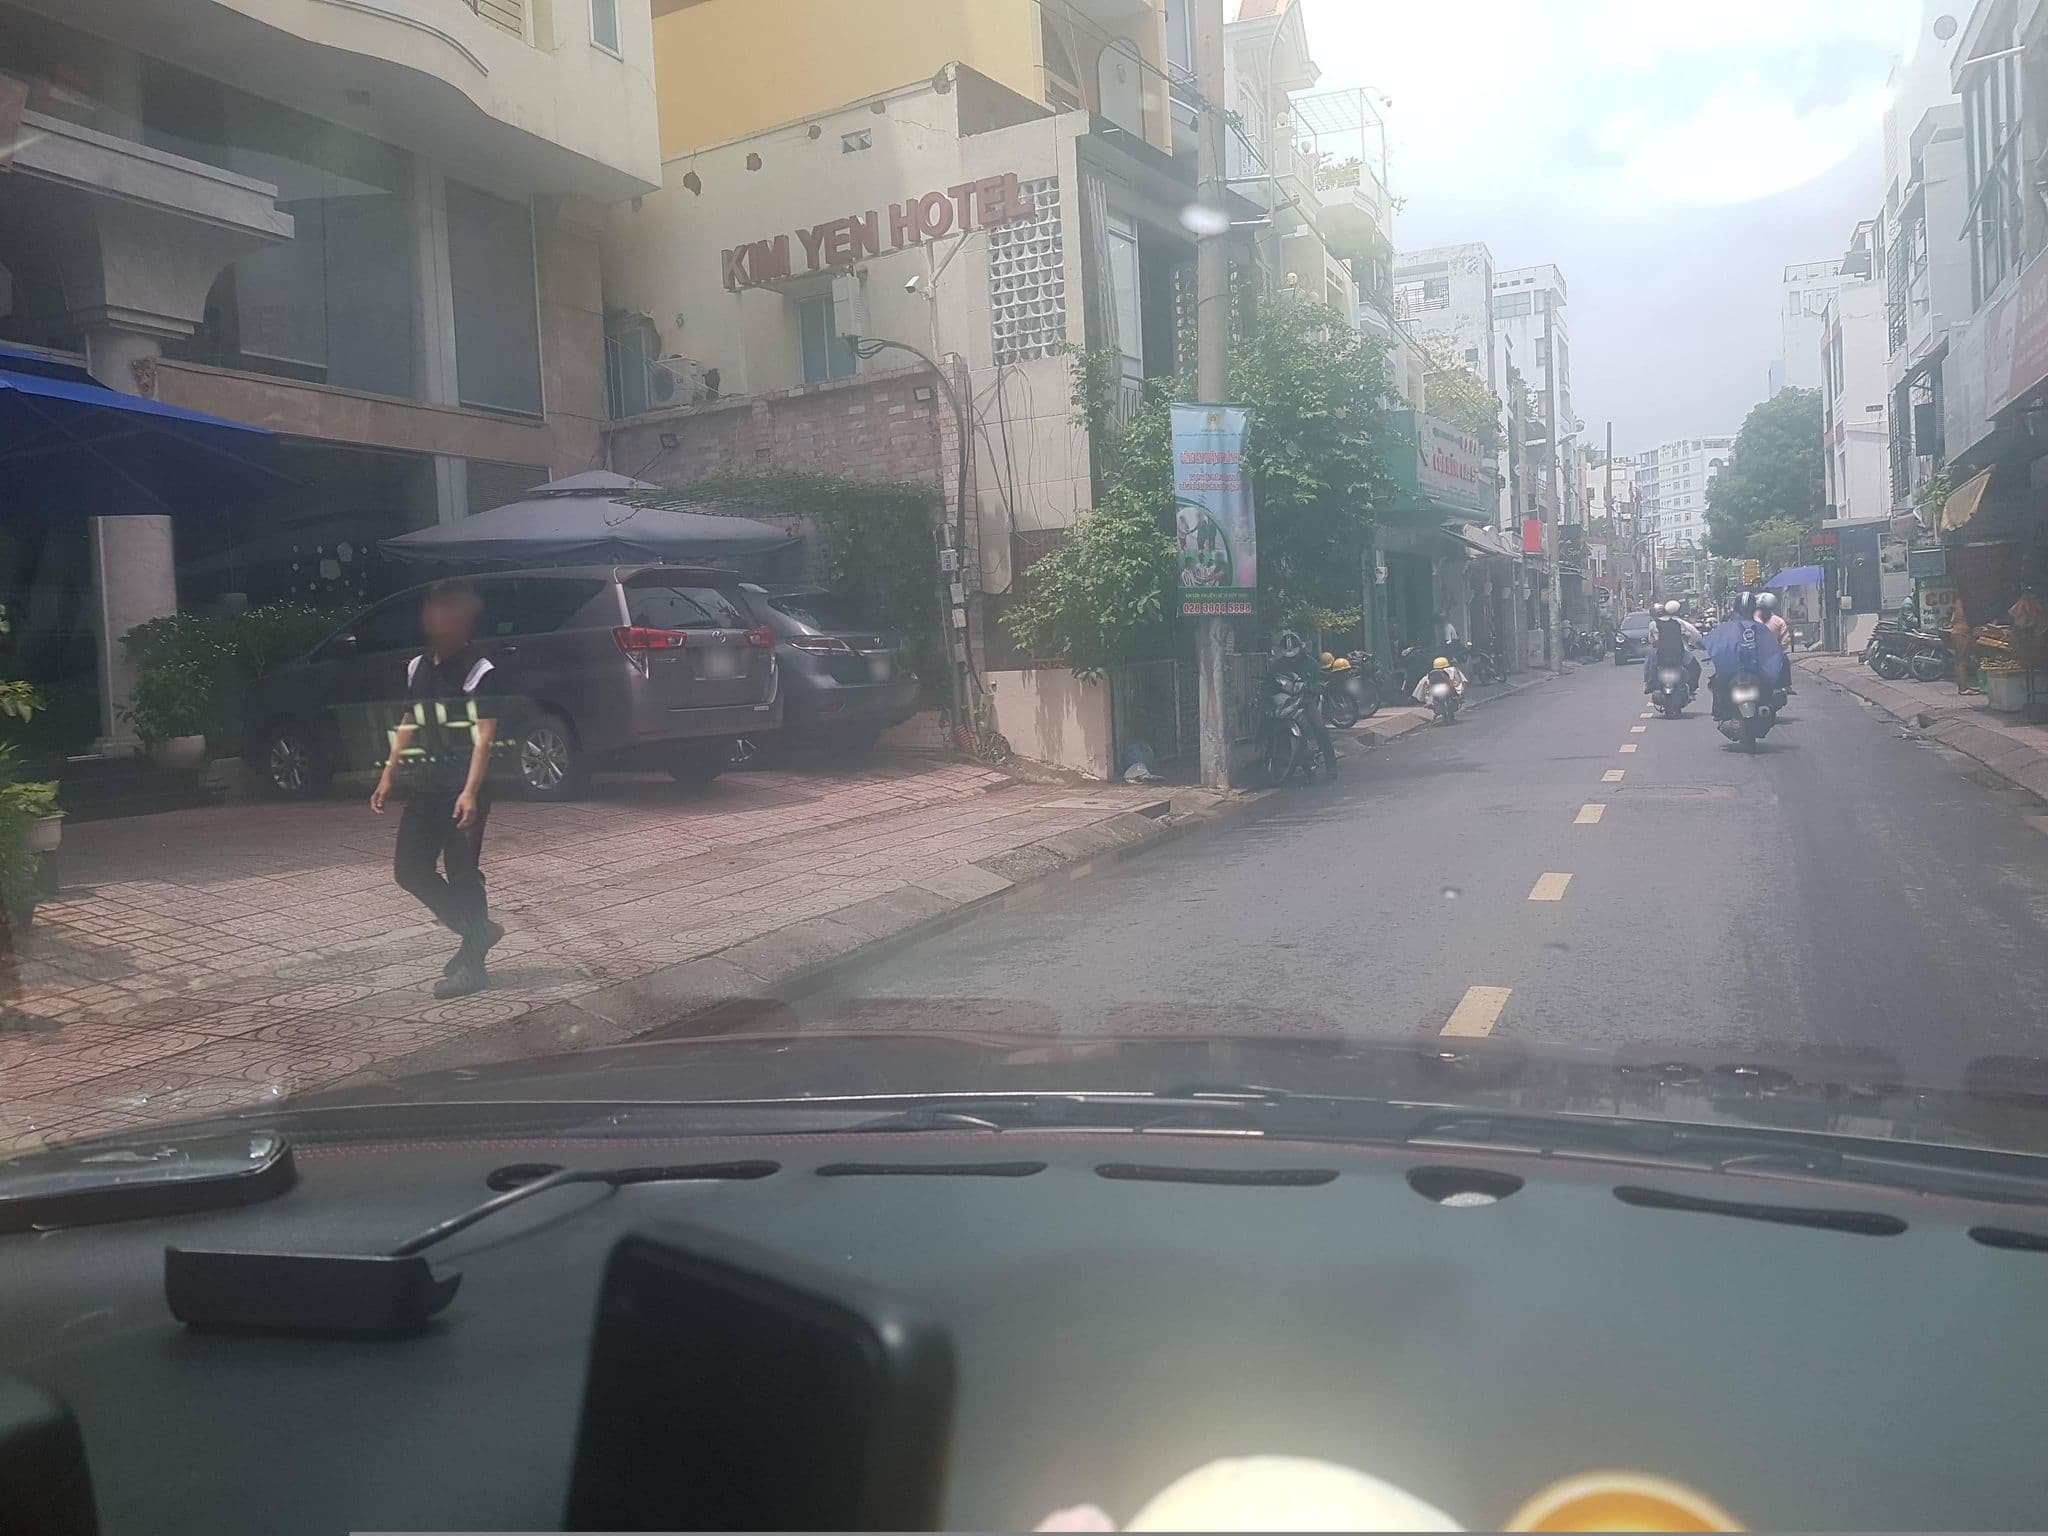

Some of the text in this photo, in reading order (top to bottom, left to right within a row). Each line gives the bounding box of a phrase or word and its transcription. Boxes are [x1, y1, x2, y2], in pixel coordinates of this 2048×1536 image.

[721, 172, 1035, 290] KIM YEN HOTEL
